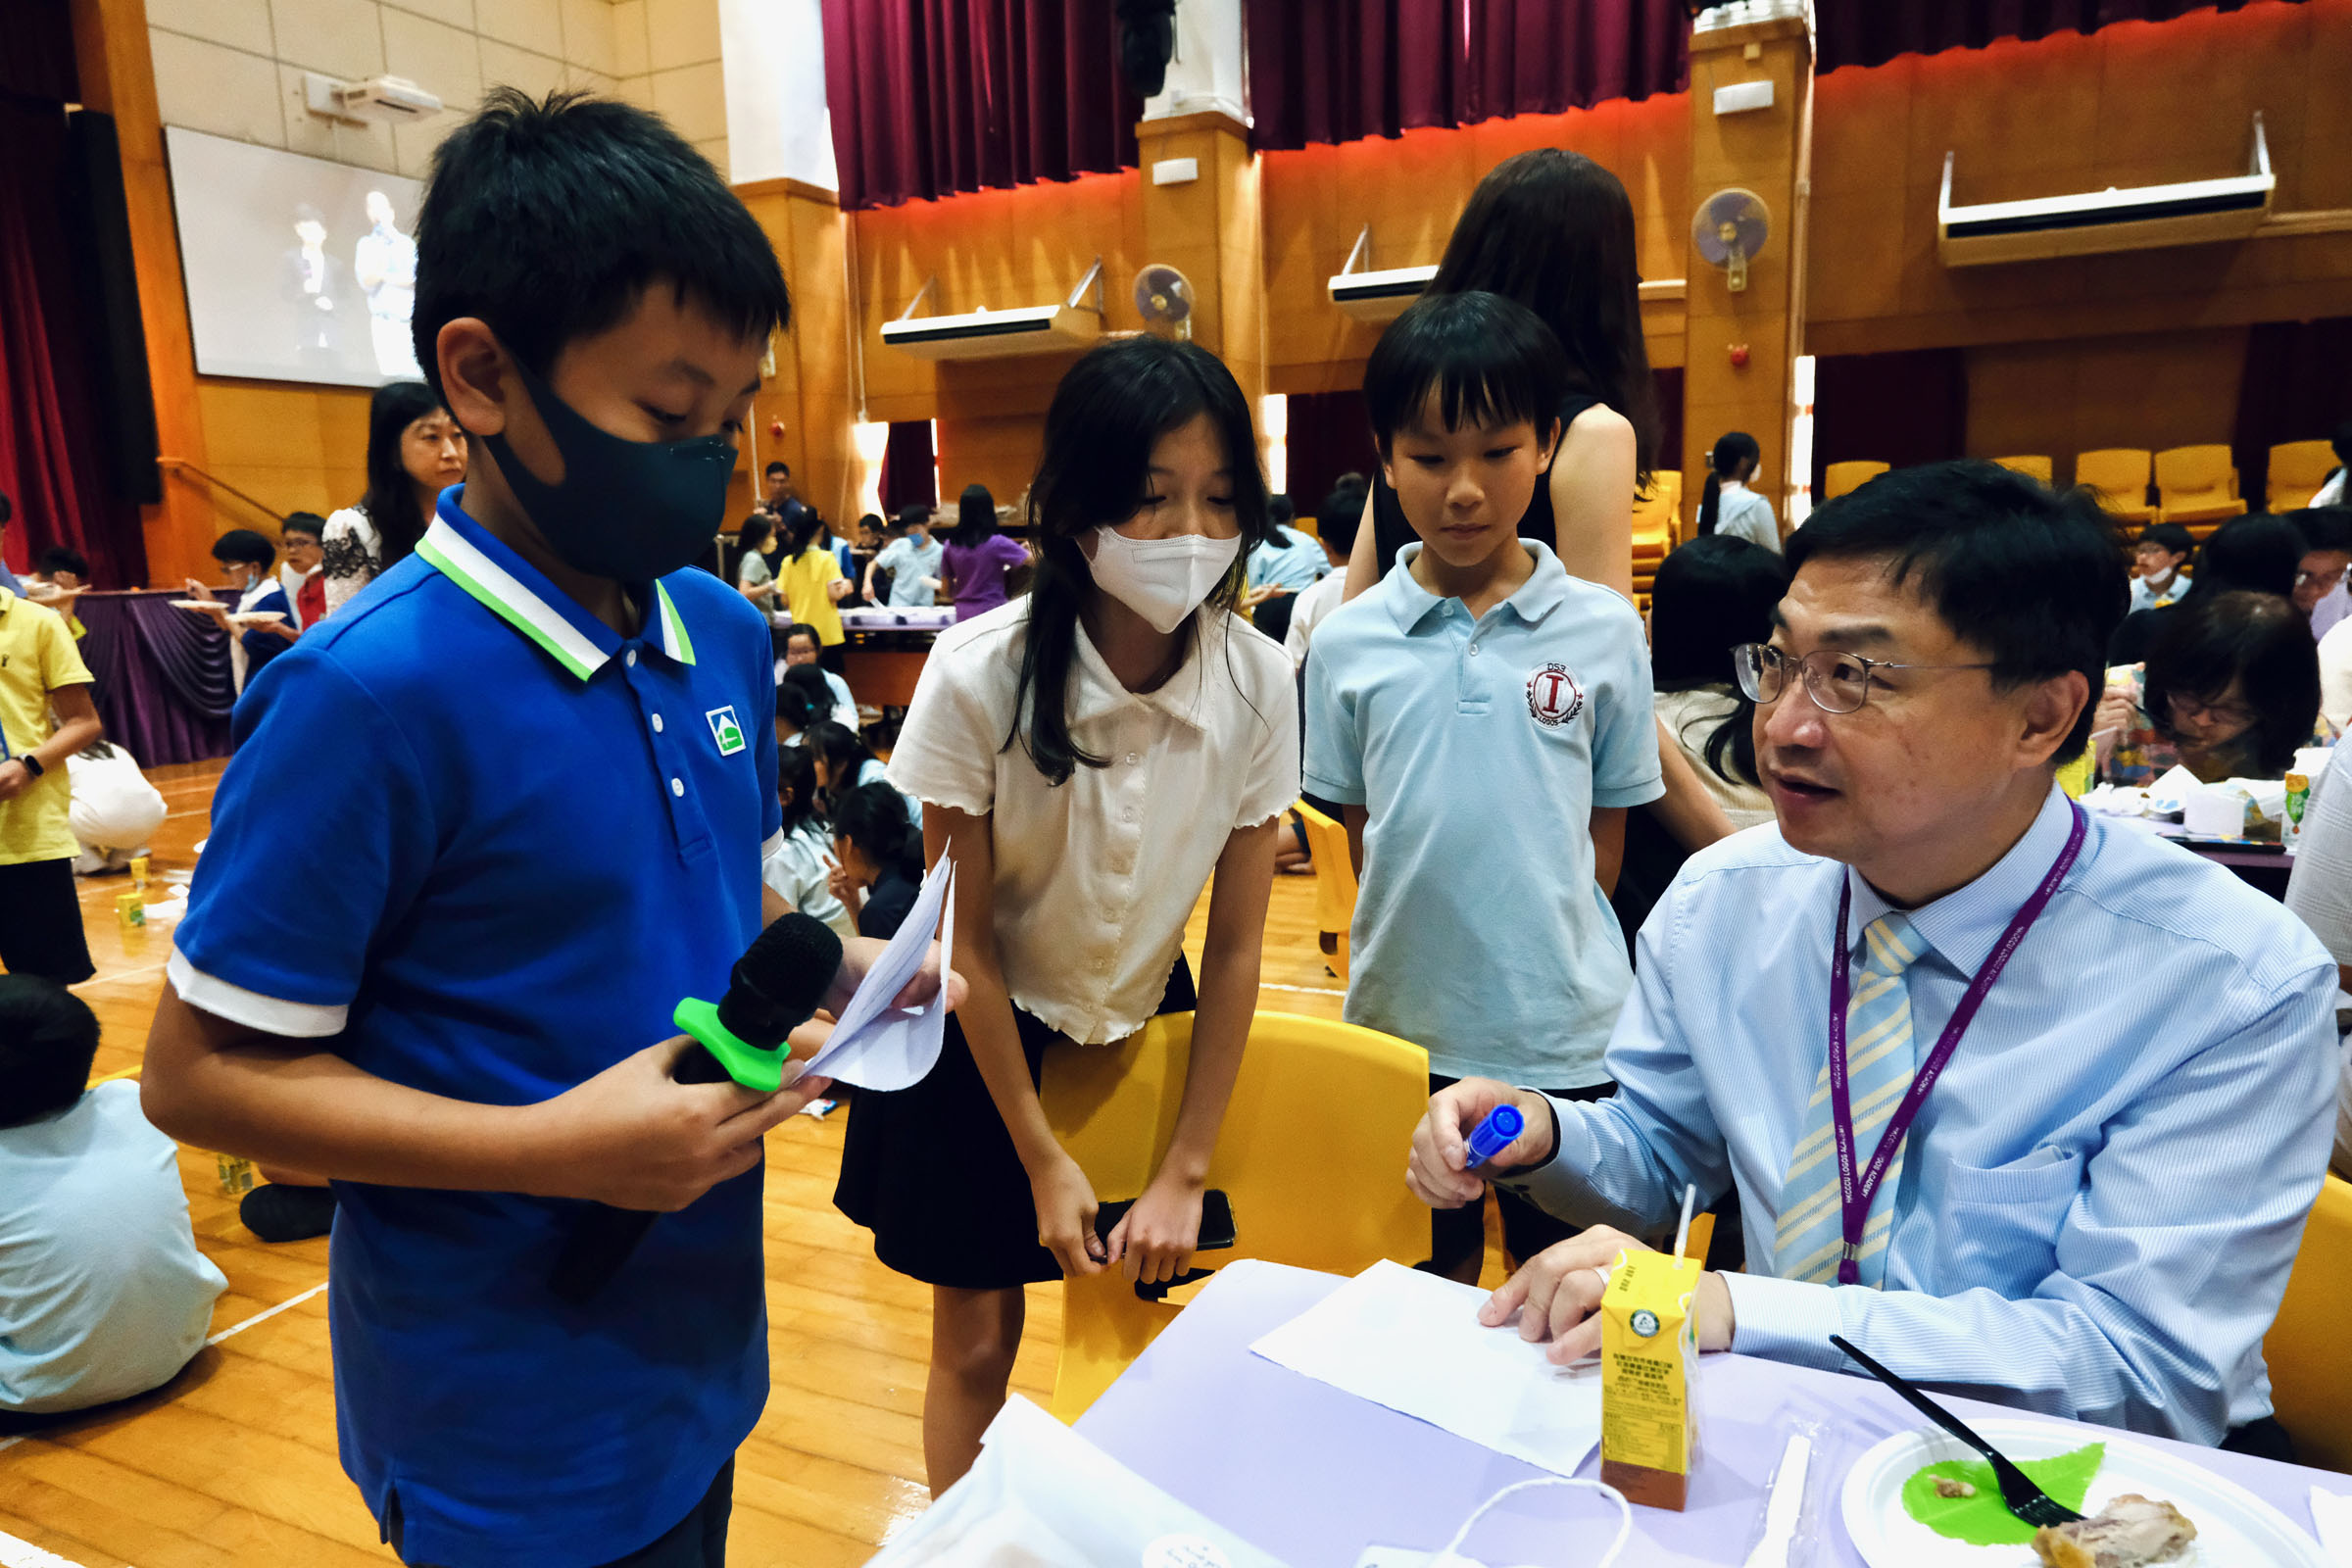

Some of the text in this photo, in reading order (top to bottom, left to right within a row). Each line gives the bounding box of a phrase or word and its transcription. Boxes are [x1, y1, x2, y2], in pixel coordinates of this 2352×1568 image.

[1539, 715, 1559, 726] LOGOS
[1840, 1153, 1850, 1176] LOGOS
[1842, 1176, 1853, 1202] HKCCCU
[1859, 1169, 1878, 1198] ACADEMY
